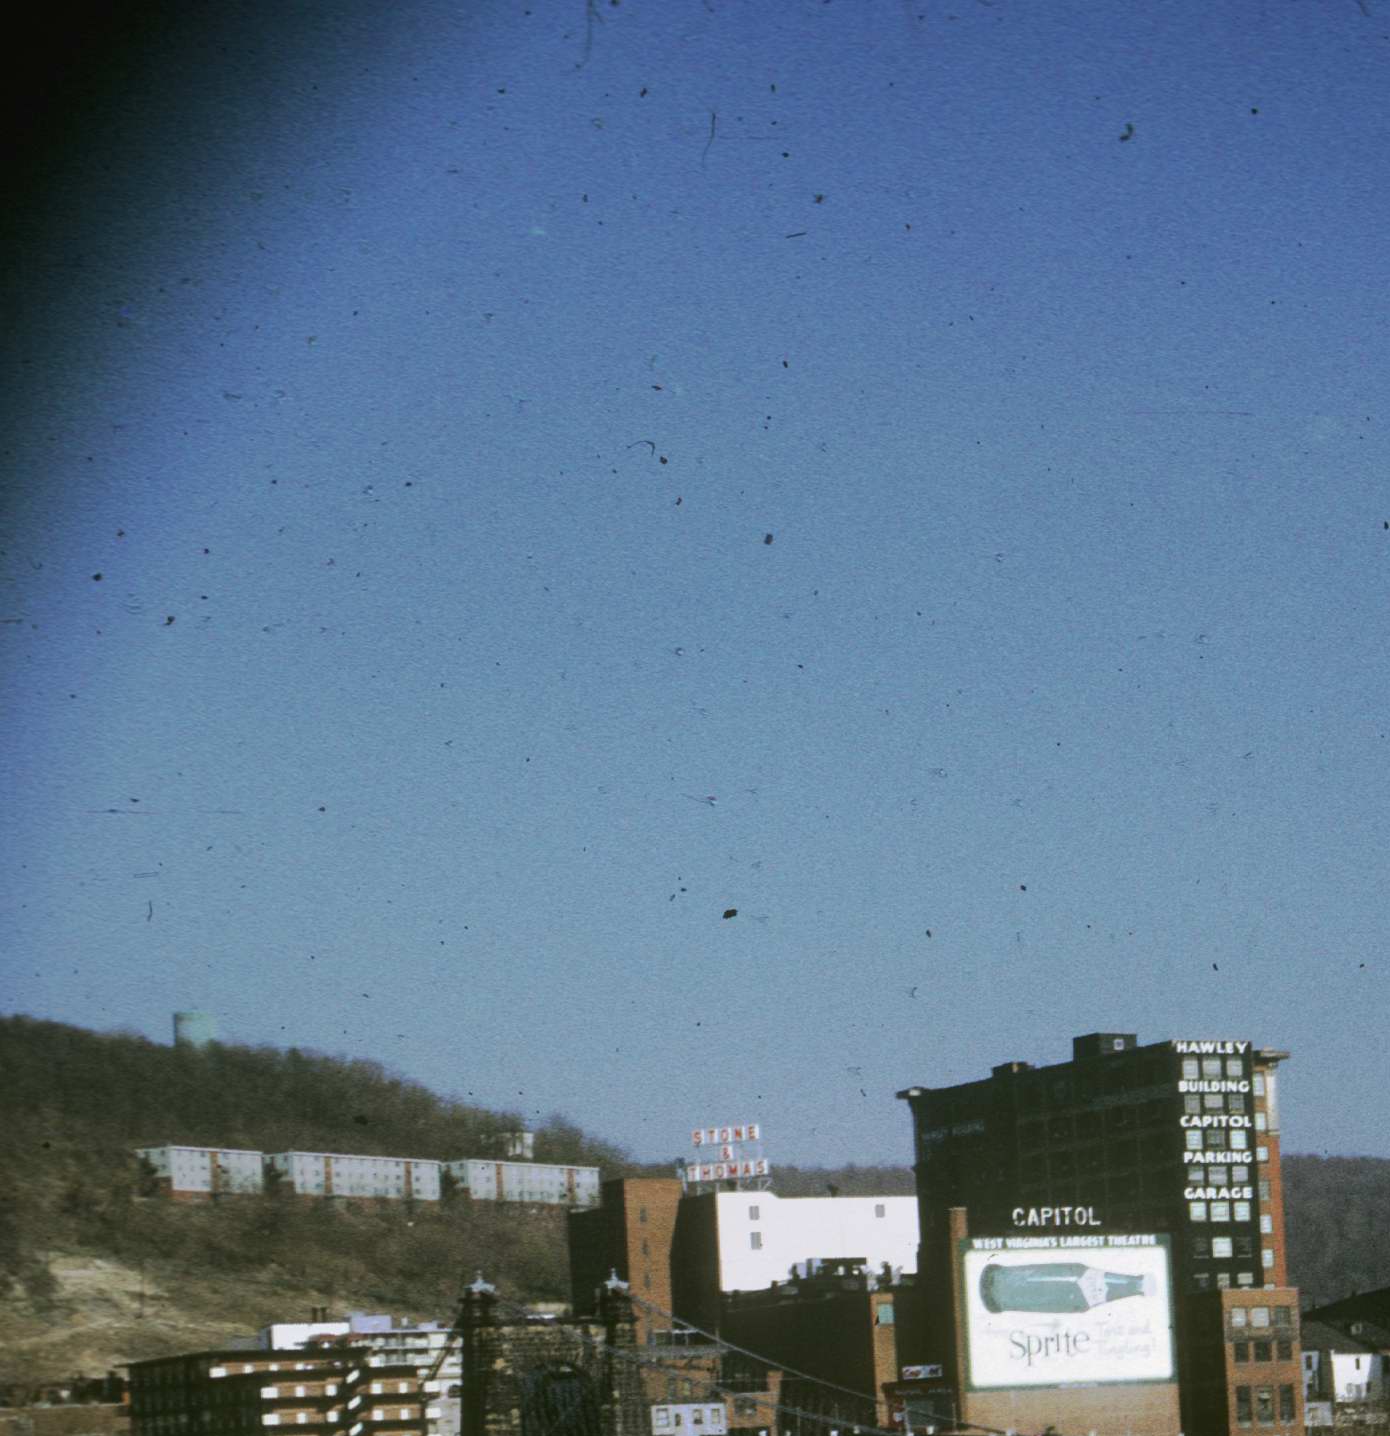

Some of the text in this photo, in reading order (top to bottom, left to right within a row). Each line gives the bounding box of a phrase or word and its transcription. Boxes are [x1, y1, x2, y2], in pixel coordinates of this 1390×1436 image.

[1176, 1041, 1248, 1054] HAWLEY
[1177, 1080, 1250, 1093] BUILDING
[1179, 1115, 1252, 1128] CAPITOL
[691, 1125, 758, 1146] STONE
[722, 1146, 731, 1160] &
[1183, 1151, 1252, 1163] PARKING
[689, 1160, 766, 1180] THOMAS
[1183, 1187, 1253, 1200] GARAGE
[1011, 1206, 1102, 1227] CAPITOL
[972, 1238, 1003, 1249] WEST
[1059, 1235, 1105, 1248] LARGEST
[1107, 1234, 1157, 1247] THEATRE
[1008, 1329, 1090, 1367] Sprite
